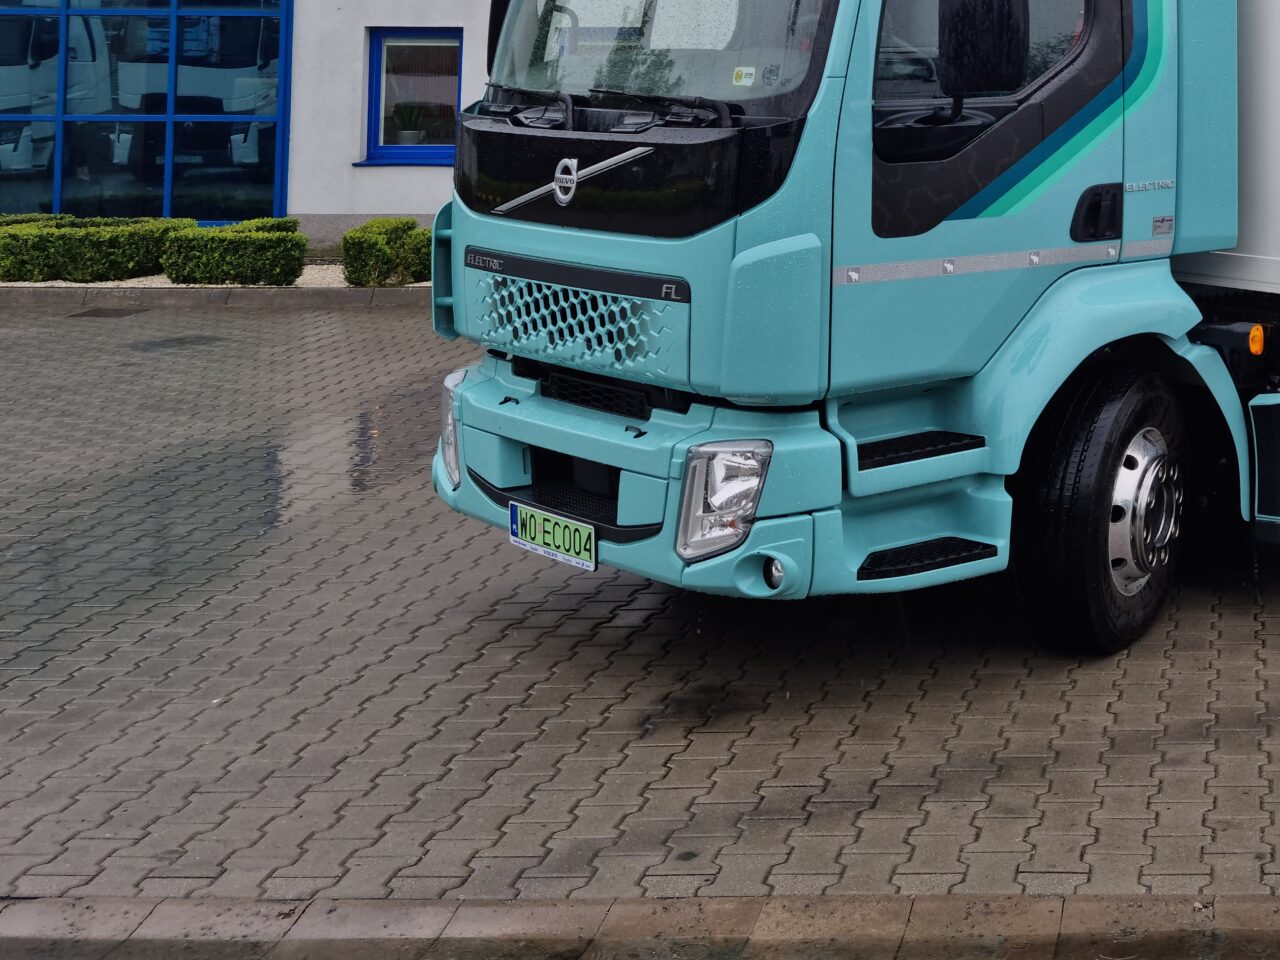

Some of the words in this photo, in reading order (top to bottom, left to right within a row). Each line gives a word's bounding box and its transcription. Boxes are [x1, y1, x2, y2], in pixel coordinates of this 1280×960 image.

[1124, 180, 1175, 193] ELECTRIC
[467, 253, 503, 271] ELECTRIC
[661, 283, 681, 300] FL
